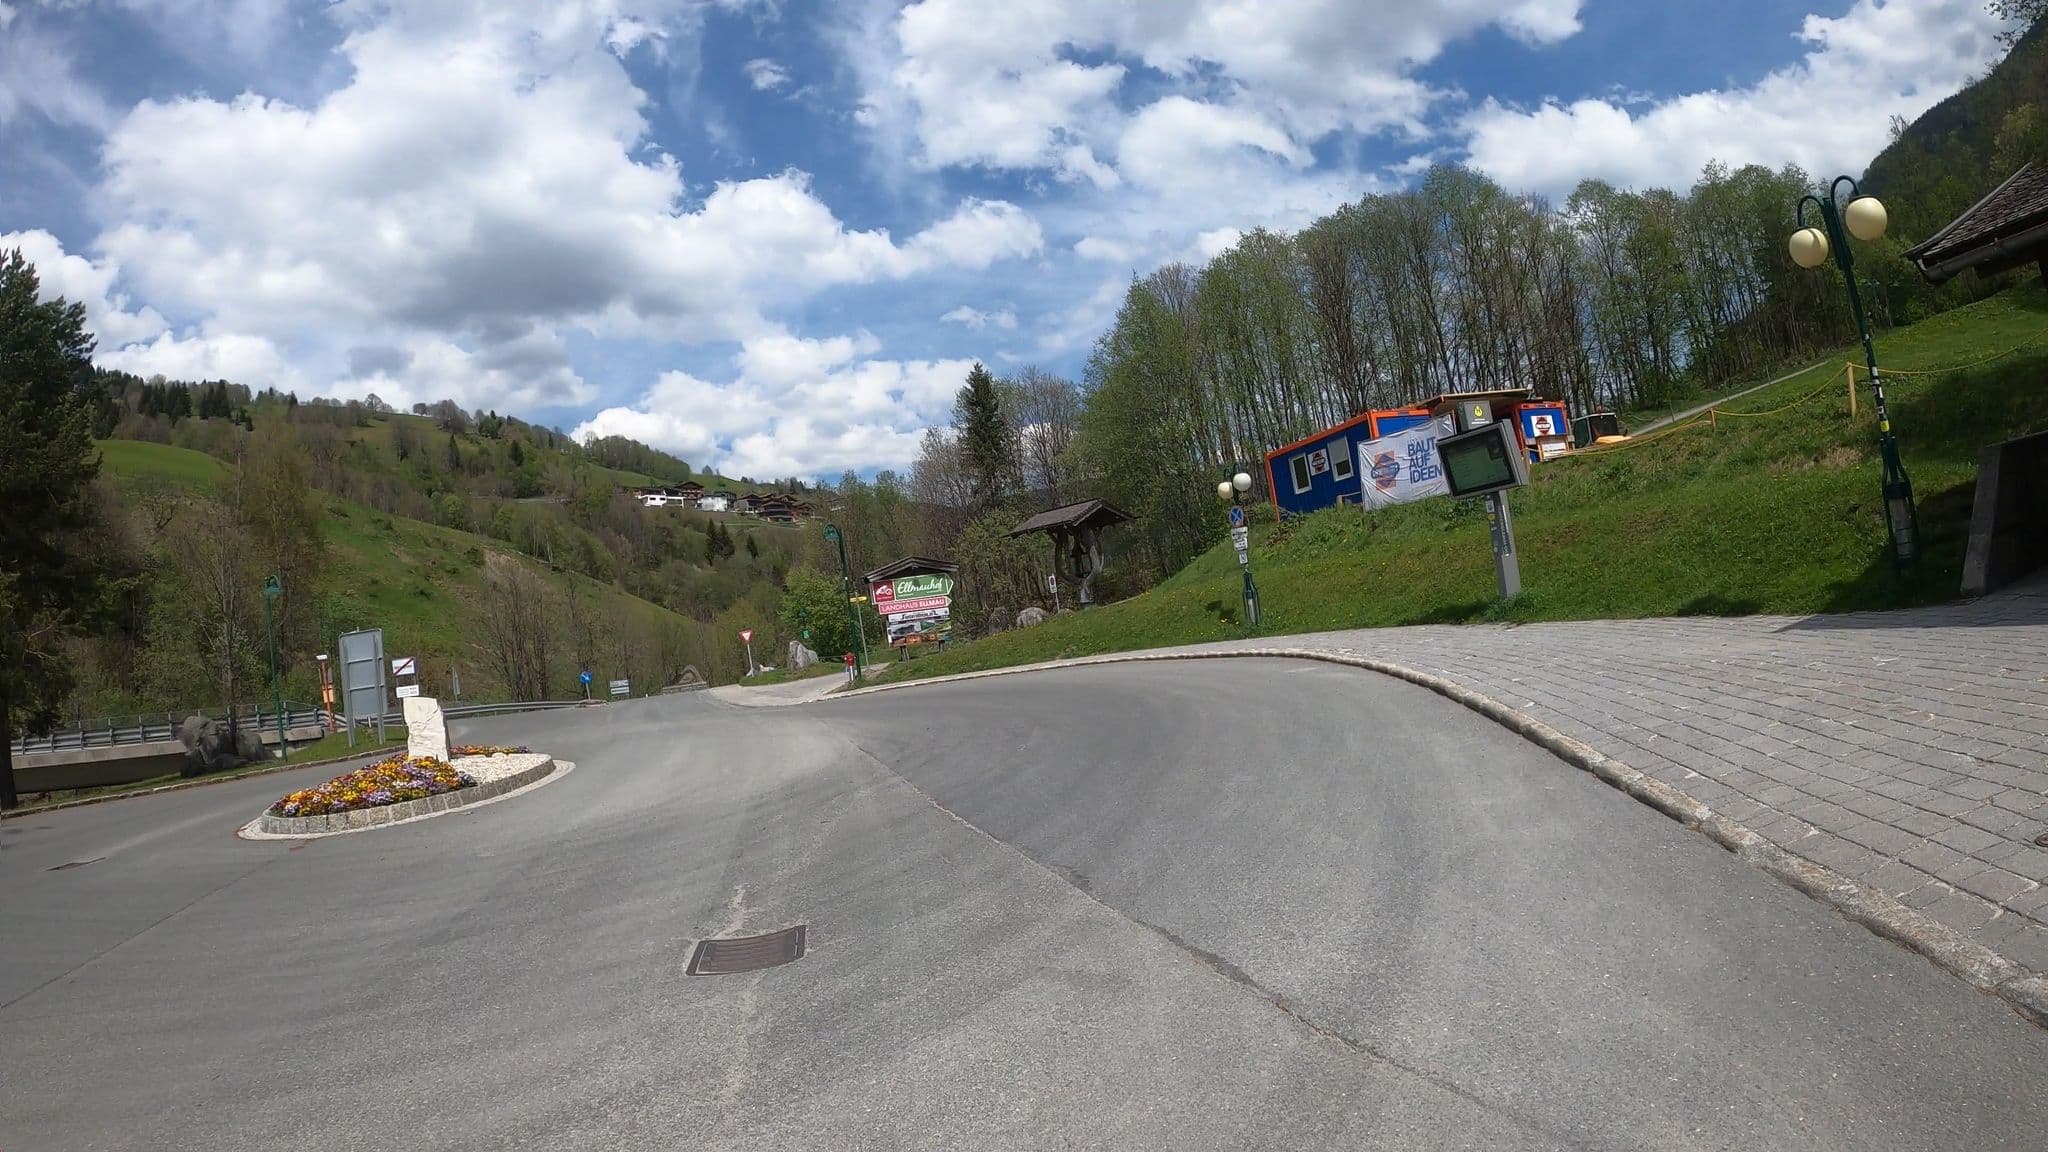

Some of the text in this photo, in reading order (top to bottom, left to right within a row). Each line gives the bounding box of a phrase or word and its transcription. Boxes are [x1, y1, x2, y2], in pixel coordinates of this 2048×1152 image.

[1408, 436, 1436, 457] BAUT
[1409, 453, 1431, 470] AUF
[1410, 464, 1443, 484] IDEEN
[897, 577, 943, 594] Ellmauhof
[881, 598, 945, 612] LANDHAUS ELLMAU
